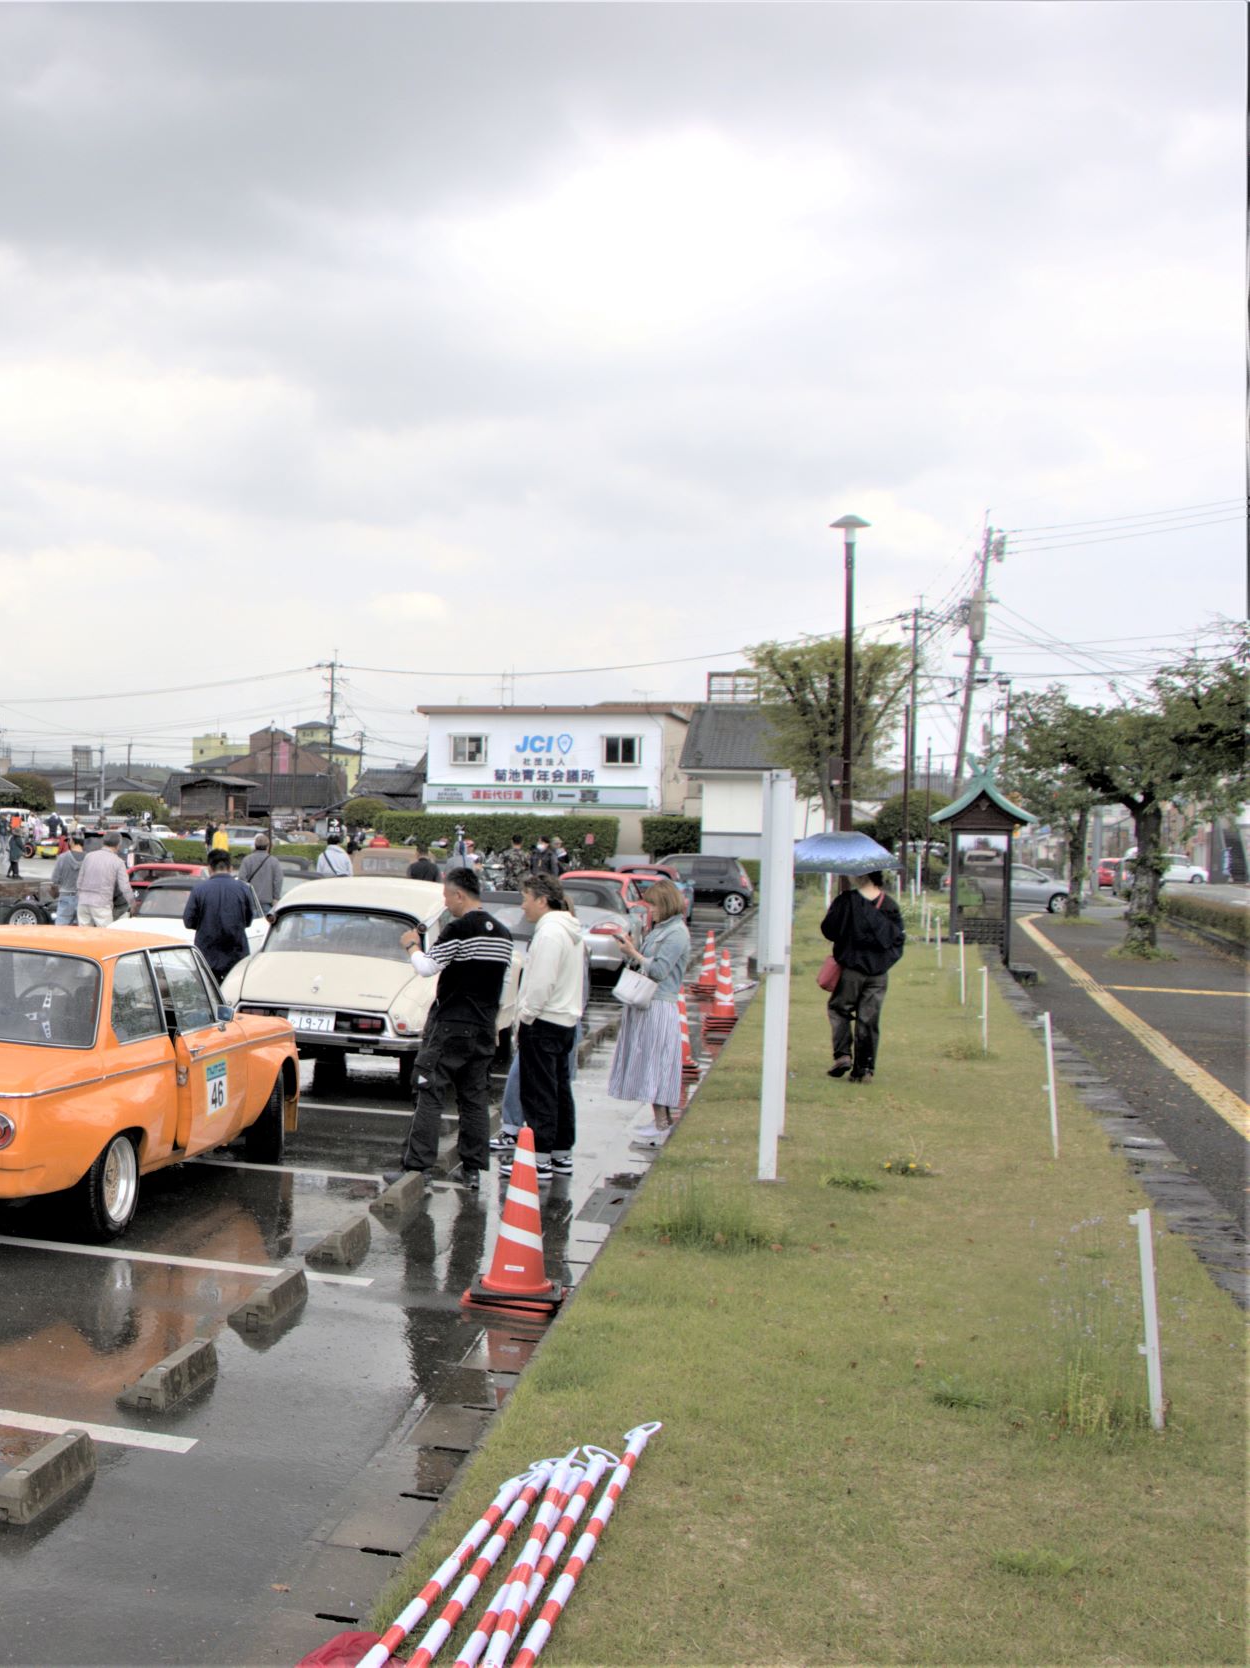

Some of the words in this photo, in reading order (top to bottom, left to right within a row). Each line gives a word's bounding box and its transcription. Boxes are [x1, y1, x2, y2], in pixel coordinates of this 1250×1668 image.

[515, 735, 553, 753] JCI
[494, 769, 595, 783] 菊池青年会議所
[144, 811, 151, 820] P
[299, 1016, 330, 1033] 19-71
[211, 1080, 224, 1109] 46
